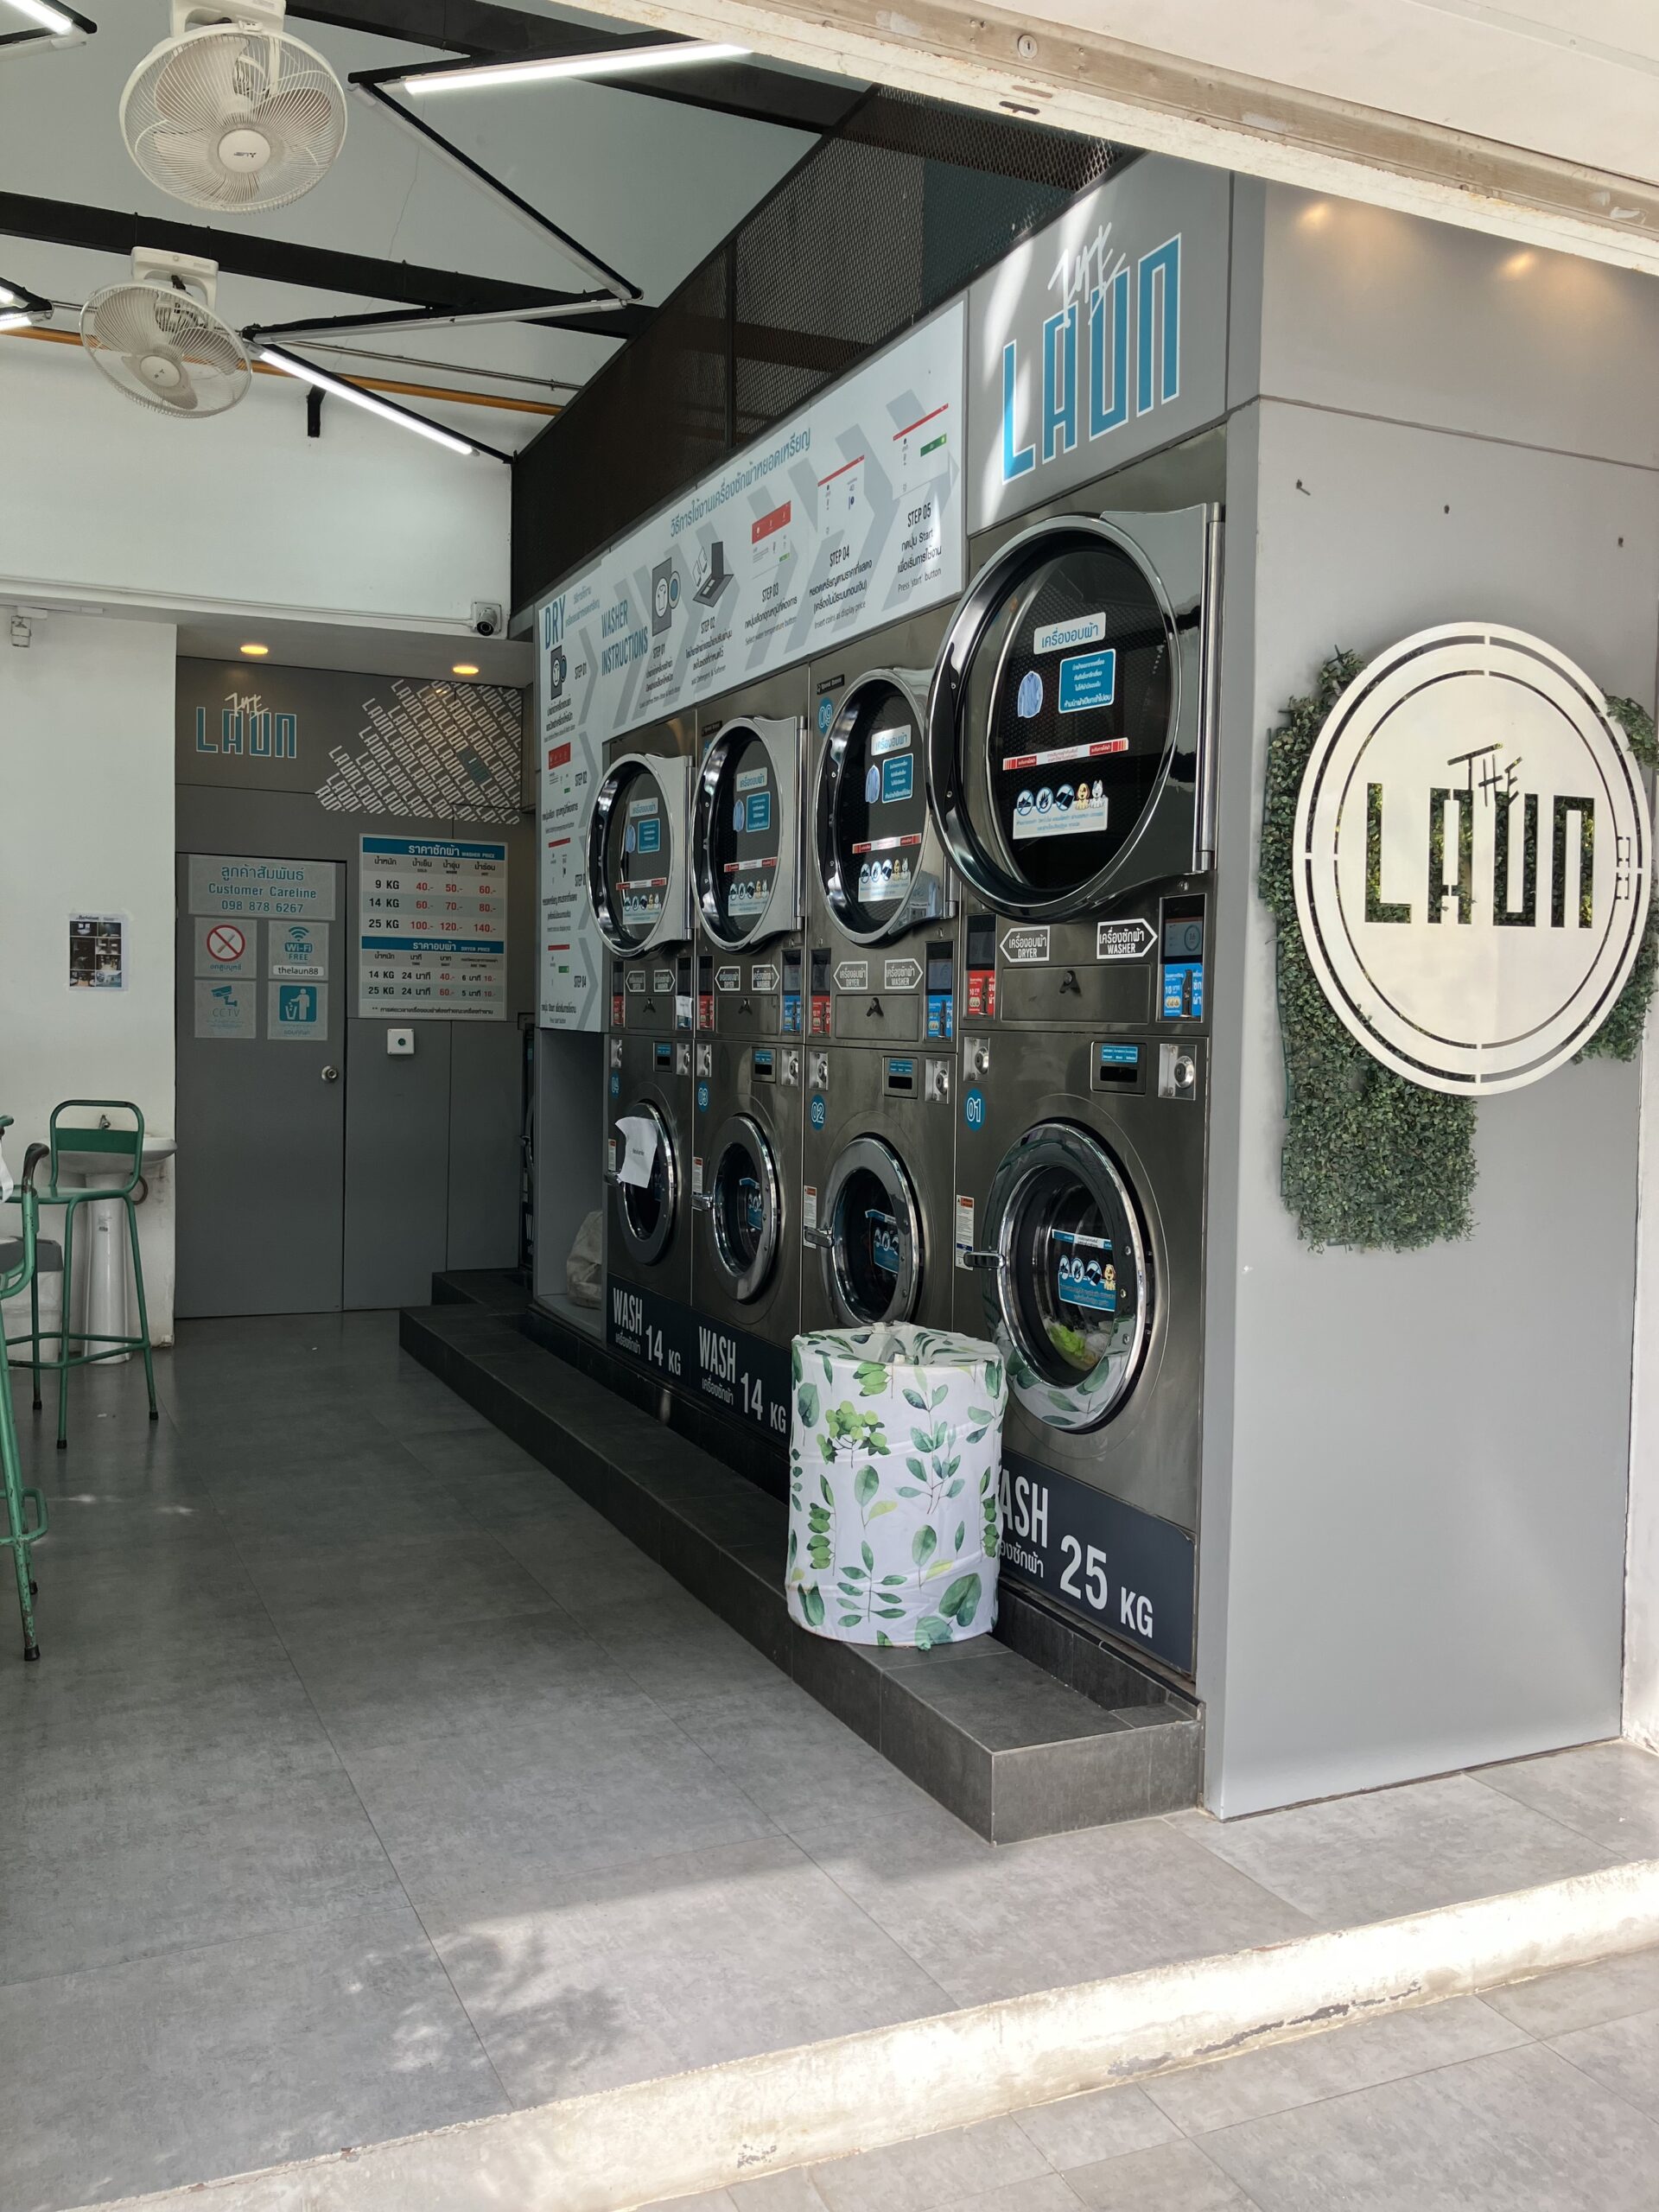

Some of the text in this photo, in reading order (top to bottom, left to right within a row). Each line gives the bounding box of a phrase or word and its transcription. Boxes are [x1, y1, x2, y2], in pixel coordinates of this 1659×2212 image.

[1048, 222, 1126, 328] THE
[1002, 232, 1181, 486] LAUN
[670, 427, 810, 537] วิธีการใช้งานเครื่องซักผ้าหยอดเหรียญ
[907, 502, 931, 528] STEP 05
[901, 529, 933, 551] กดปุ่ม Start
[830, 545, 849, 567] STEP 04
[761, 582, 779, 602] STEP 03
[898, 568, 942, 593] Press button
[545, 594, 566, 650] DRY
[601, 600, 629, 639] WASHER
[701, 620, 709, 633] STEP
[815, 617, 826, 629] Insert
[1041, 622, 1098, 648] เครื่องอบผ้า
[601, 626, 648, 677] INSTRUCTIONS
[391, 679, 424, 718] LAUN
[416, 686, 450, 723] LAUN
[361, 700, 396, 738] LAUN
[387, 706, 421, 744] LAUN
[467, 698, 499, 735] LAUN
[818, 704, 831, 728] 09
[196, 707, 297, 759] LAUN
[413, 712, 446, 749] LAUN
[463, 724, 495, 760] LAUN
[358, 727, 392, 764] LAUN
[384, 732, 417, 769] LAUN
[410, 738, 442, 774] LAUN
[328, 747, 363, 783] LAUN
[355, 752, 389, 789] LAUN
[380, 758, 414, 794] LAUN
[1447, 743, 1522, 806] THE
[406, 763, 438, 799] LAUN
[374, 855, 495, 871] น้ำหนัก น้ำเย็น น้ำอุ่น น้ำร้อน
[409, 844, 460, 856] ราคาซักผ้า
[1364, 783, 1594, 928] LAUN
[221, 863, 304, 881] ลูกค้าสัมพันธ์
[208, 883, 316, 899] Customer Careline
[375, 880, 496, 894] 9 KG 40.- 50.- 60.-
[221, 900, 303, 912] 098 878 6267
[369, 898, 496, 912] 14 KG 60.- 70.- 80.-
[368, 919, 496, 933] 25 KG 100.- 120.- 140.-
[1099, 926, 1145, 944] เครื่องซักผ้า
[286, 943, 312, 952] Wi-Fi
[413, 941, 456, 951] ราคาอบผ้า
[1009, 932, 1047, 950] เครื่องอบผ้า
[1018, 948, 1037, 959] DRYER
[1108, 943, 1136, 955] WASHER
[374, 951, 395, 960] น้ำหนัก
[278, 967, 319, 976] thelaun88
[416, 971, 431, 981] นาที
[846, 978, 860, 987] DRYER
[416, 987, 431, 996] นาที
[213, 1008, 240, 1017] CCTV
[698, 1088, 708, 1106] 03
[811, 1102, 824, 1123] 02
[967, 1098, 982, 1123] 01
[613, 1287, 643, 1336] WASH
[645, 1325, 682, 1376] 14 KG
[698, 1325, 736, 1384] WASH
[741, 1372, 786, 1434] 14 KG
[998, 1469, 1049, 1548] ASH
[1059, 1535, 1154, 1639] 25 KG
